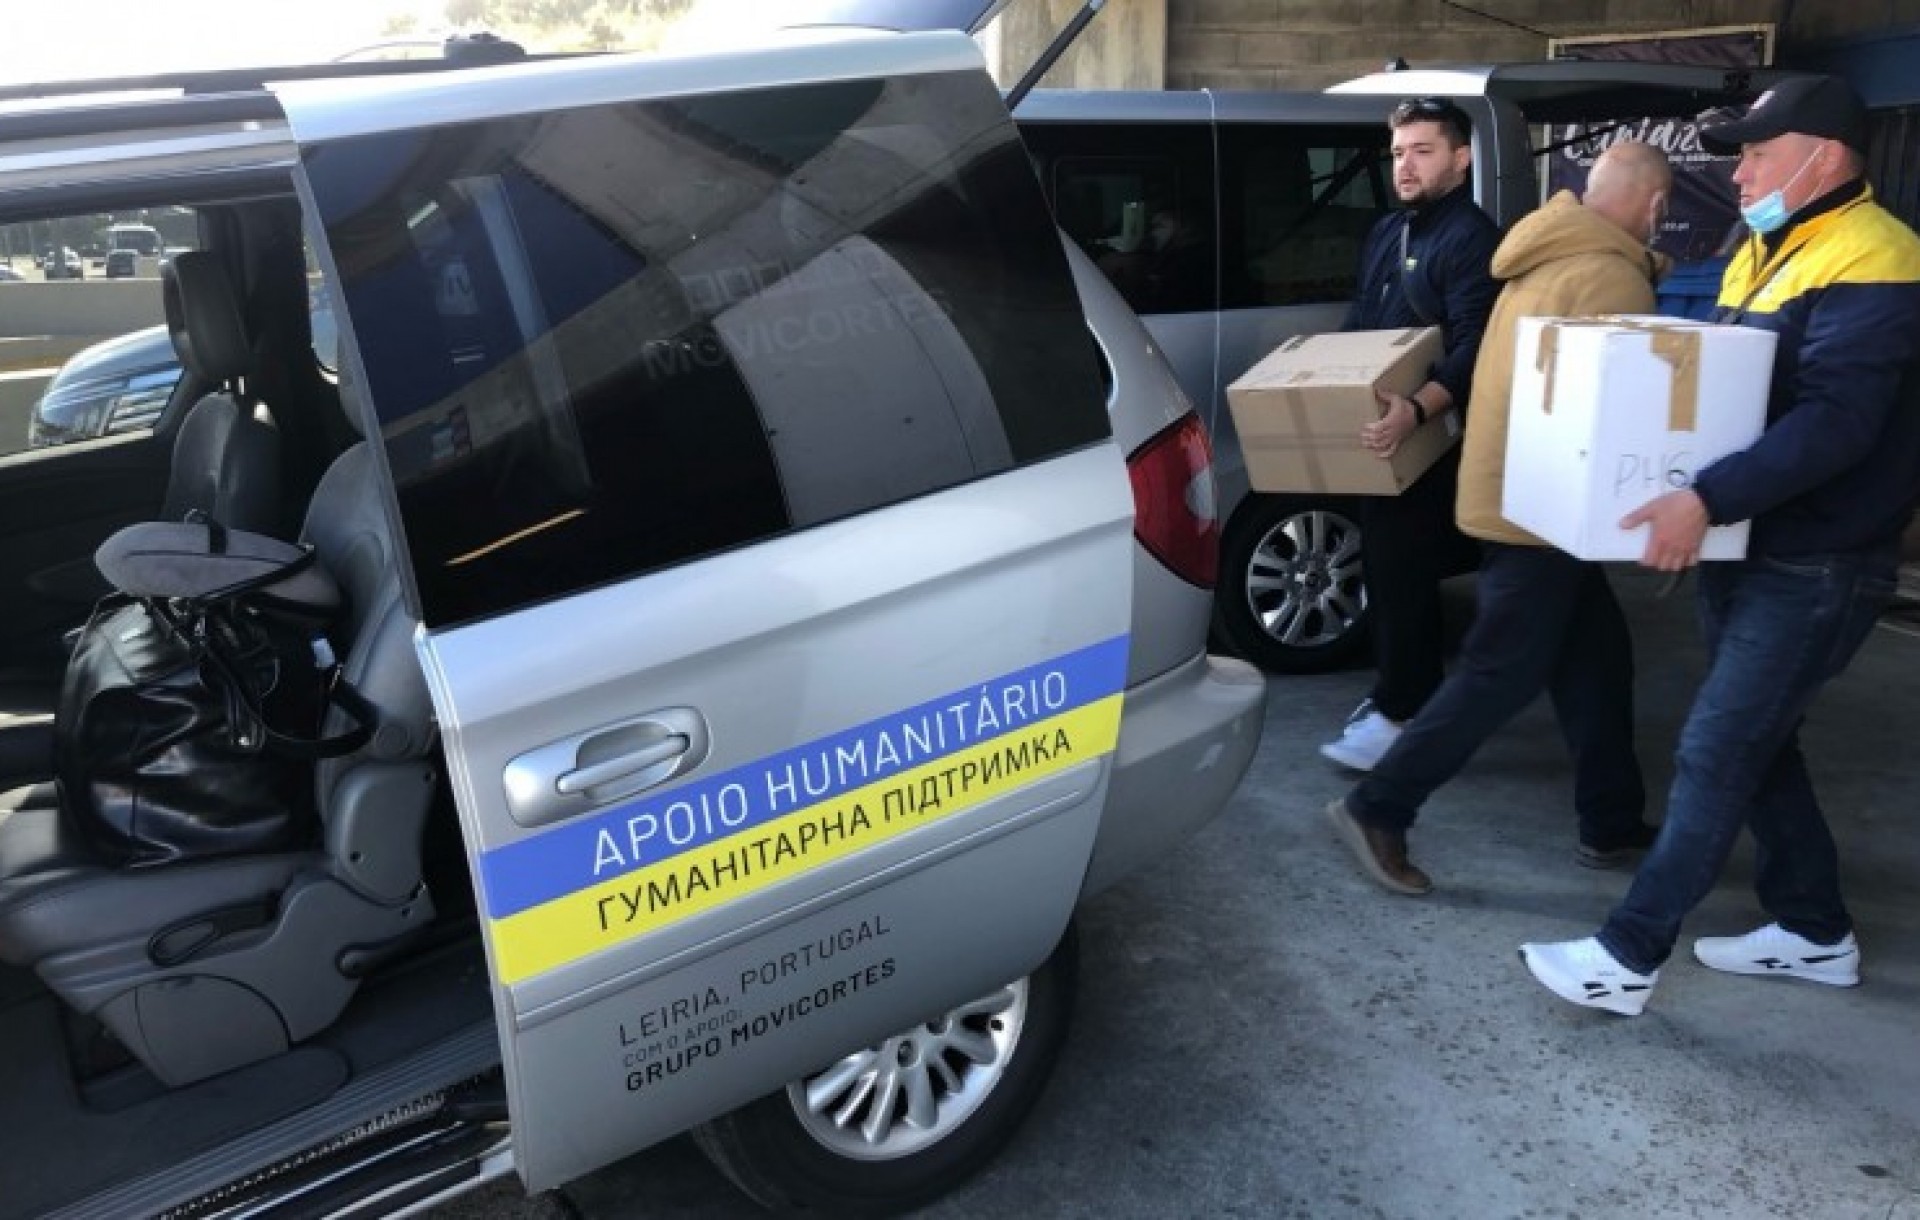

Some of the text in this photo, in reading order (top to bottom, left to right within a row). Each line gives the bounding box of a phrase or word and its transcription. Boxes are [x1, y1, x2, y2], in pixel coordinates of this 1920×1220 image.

[593, 671, 1067, 876] APOIO HUMANITÁRIO
[597, 727, 1072, 932] ГУМАНІТАРНА ПІДТРИМКА
[619, 915, 891, 1047] LEIRIA, PORTUGAL
[626, 957, 897, 1092] GRUPO MOVICORTES
[622, 1040, 663, 1068] COM
[668, 1034, 679, 1049] O
